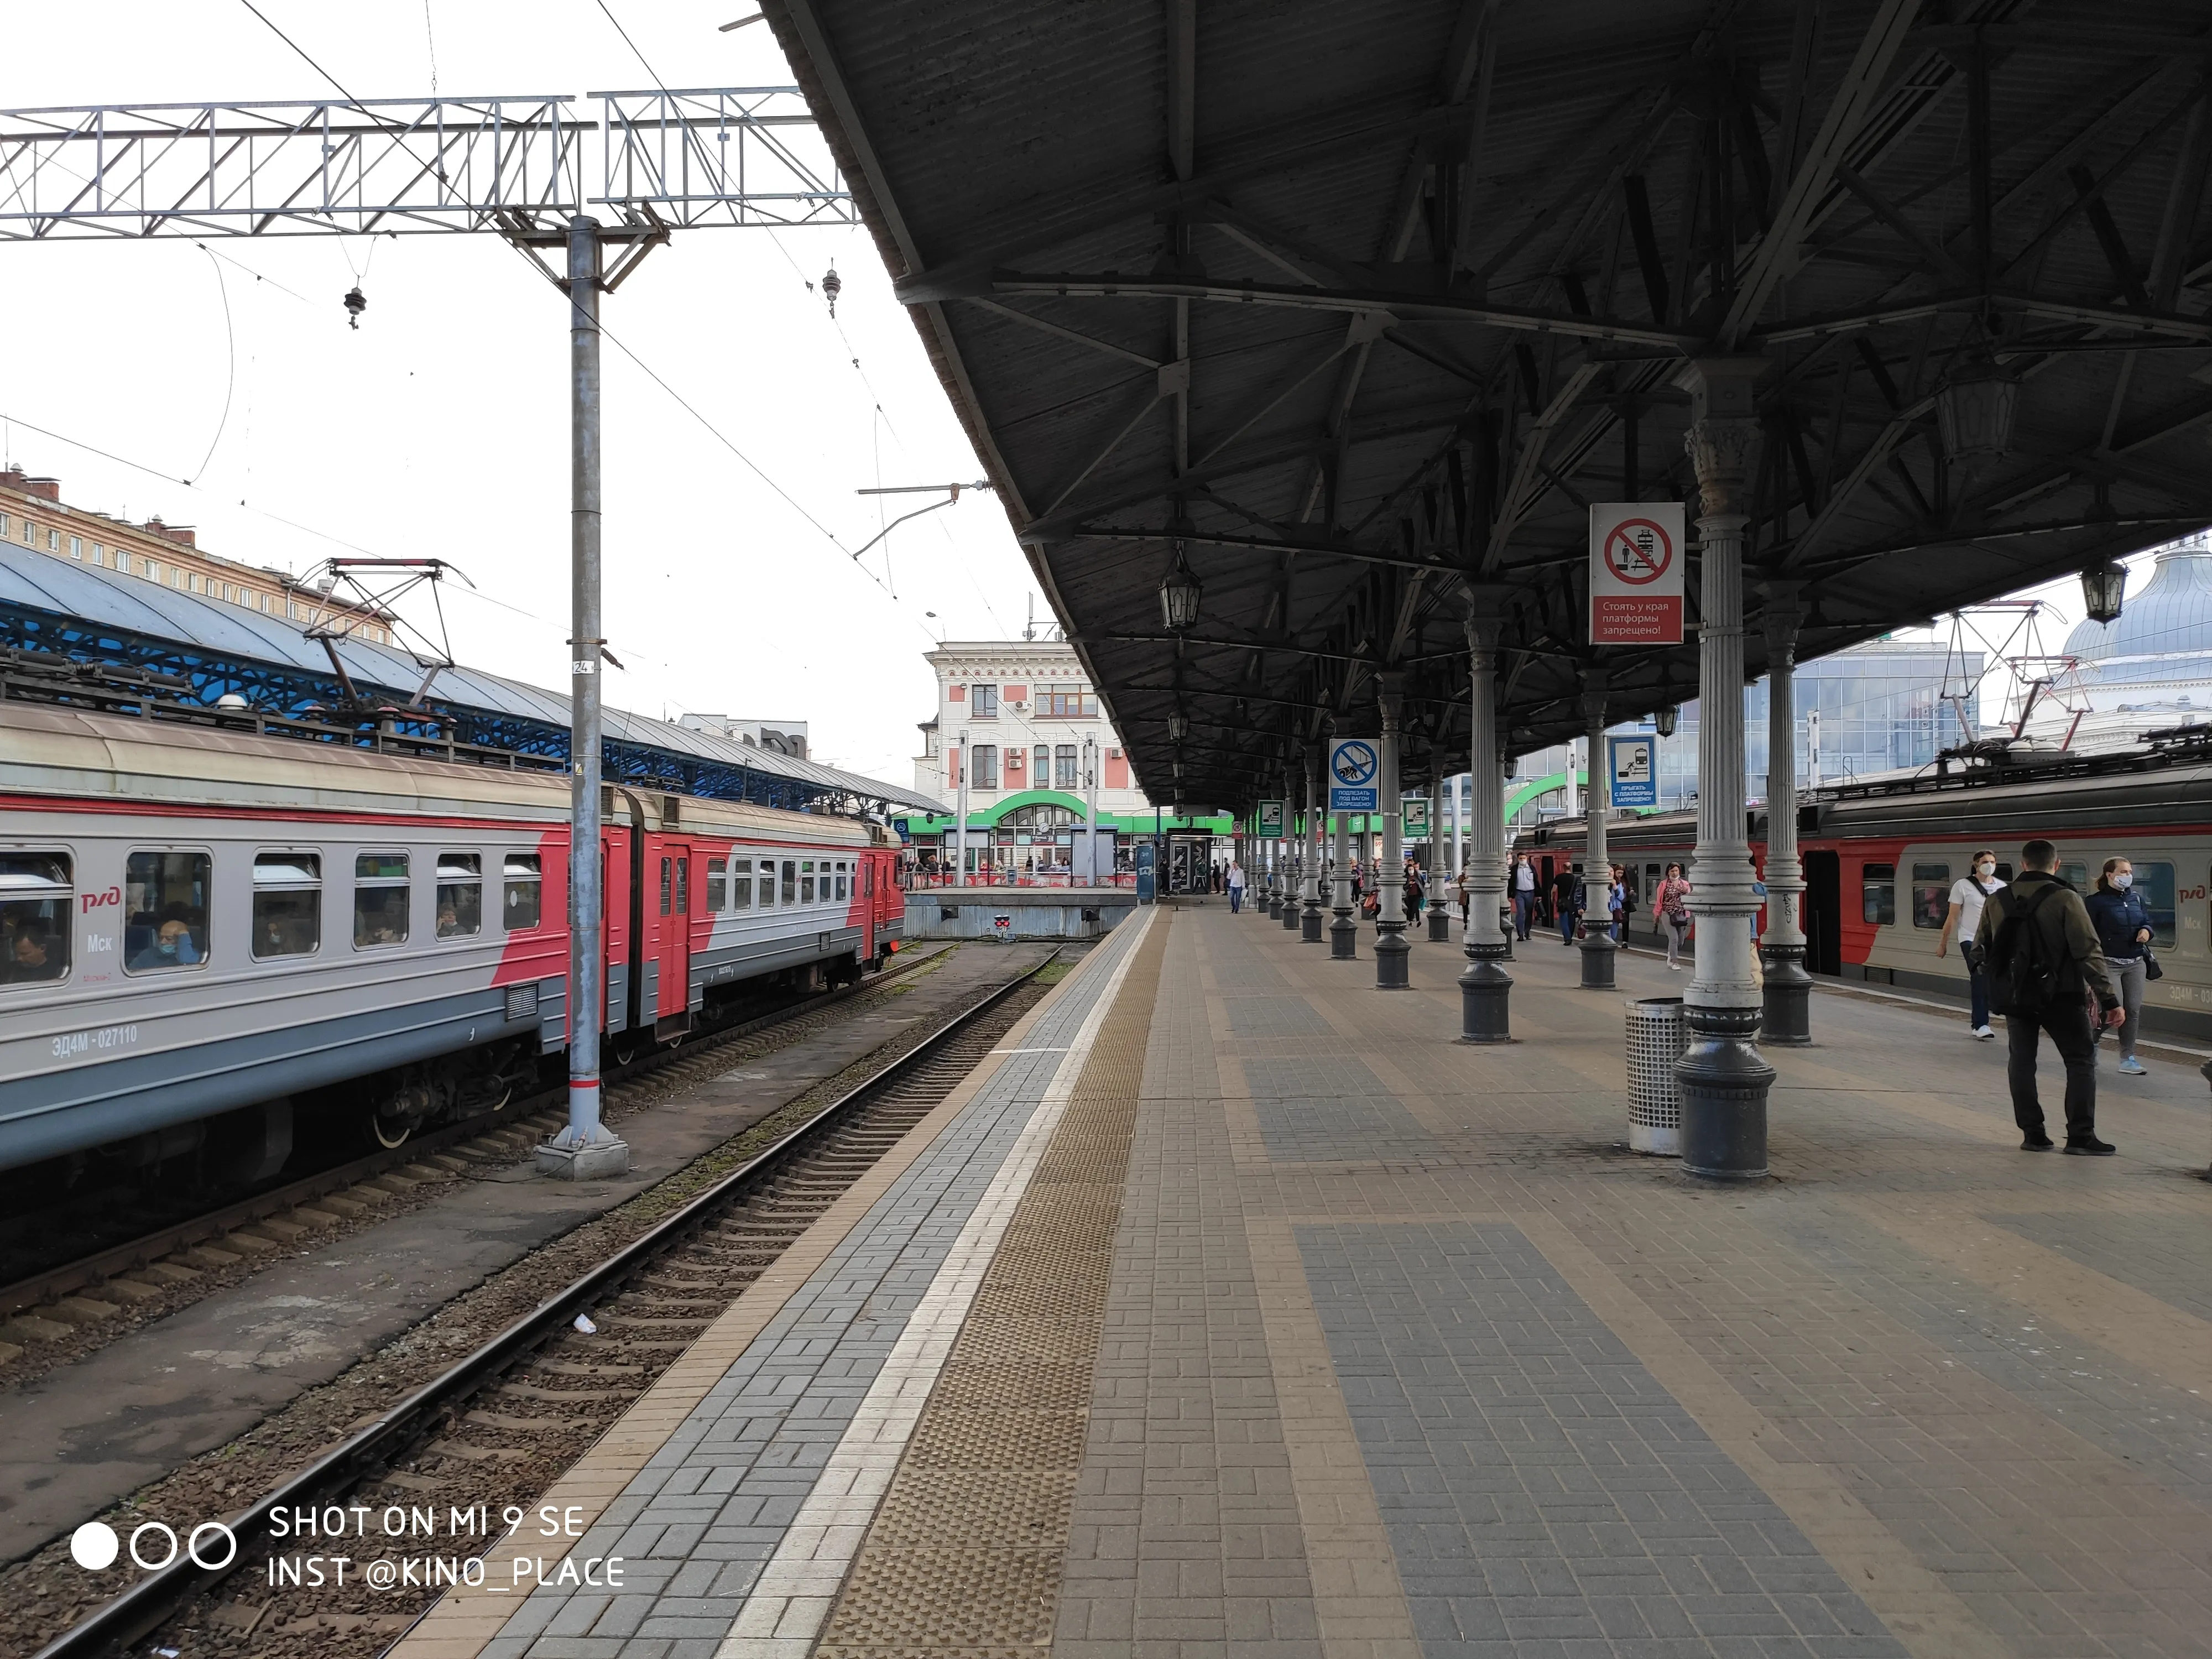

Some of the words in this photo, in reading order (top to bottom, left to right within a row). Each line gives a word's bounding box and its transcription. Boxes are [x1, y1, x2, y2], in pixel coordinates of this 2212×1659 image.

[1603, 602, 1636, 611] Стоять
[1637, 603, 1644, 613] у
[1646, 603, 1669, 613] края
[1603, 613, 1659, 625] платформы
[1603, 625, 1661, 636] запрещено!
[575, 662, 588, 672] 24
[2184, 916, 2201, 929] Мск
[87, 933, 113, 953] Мск
